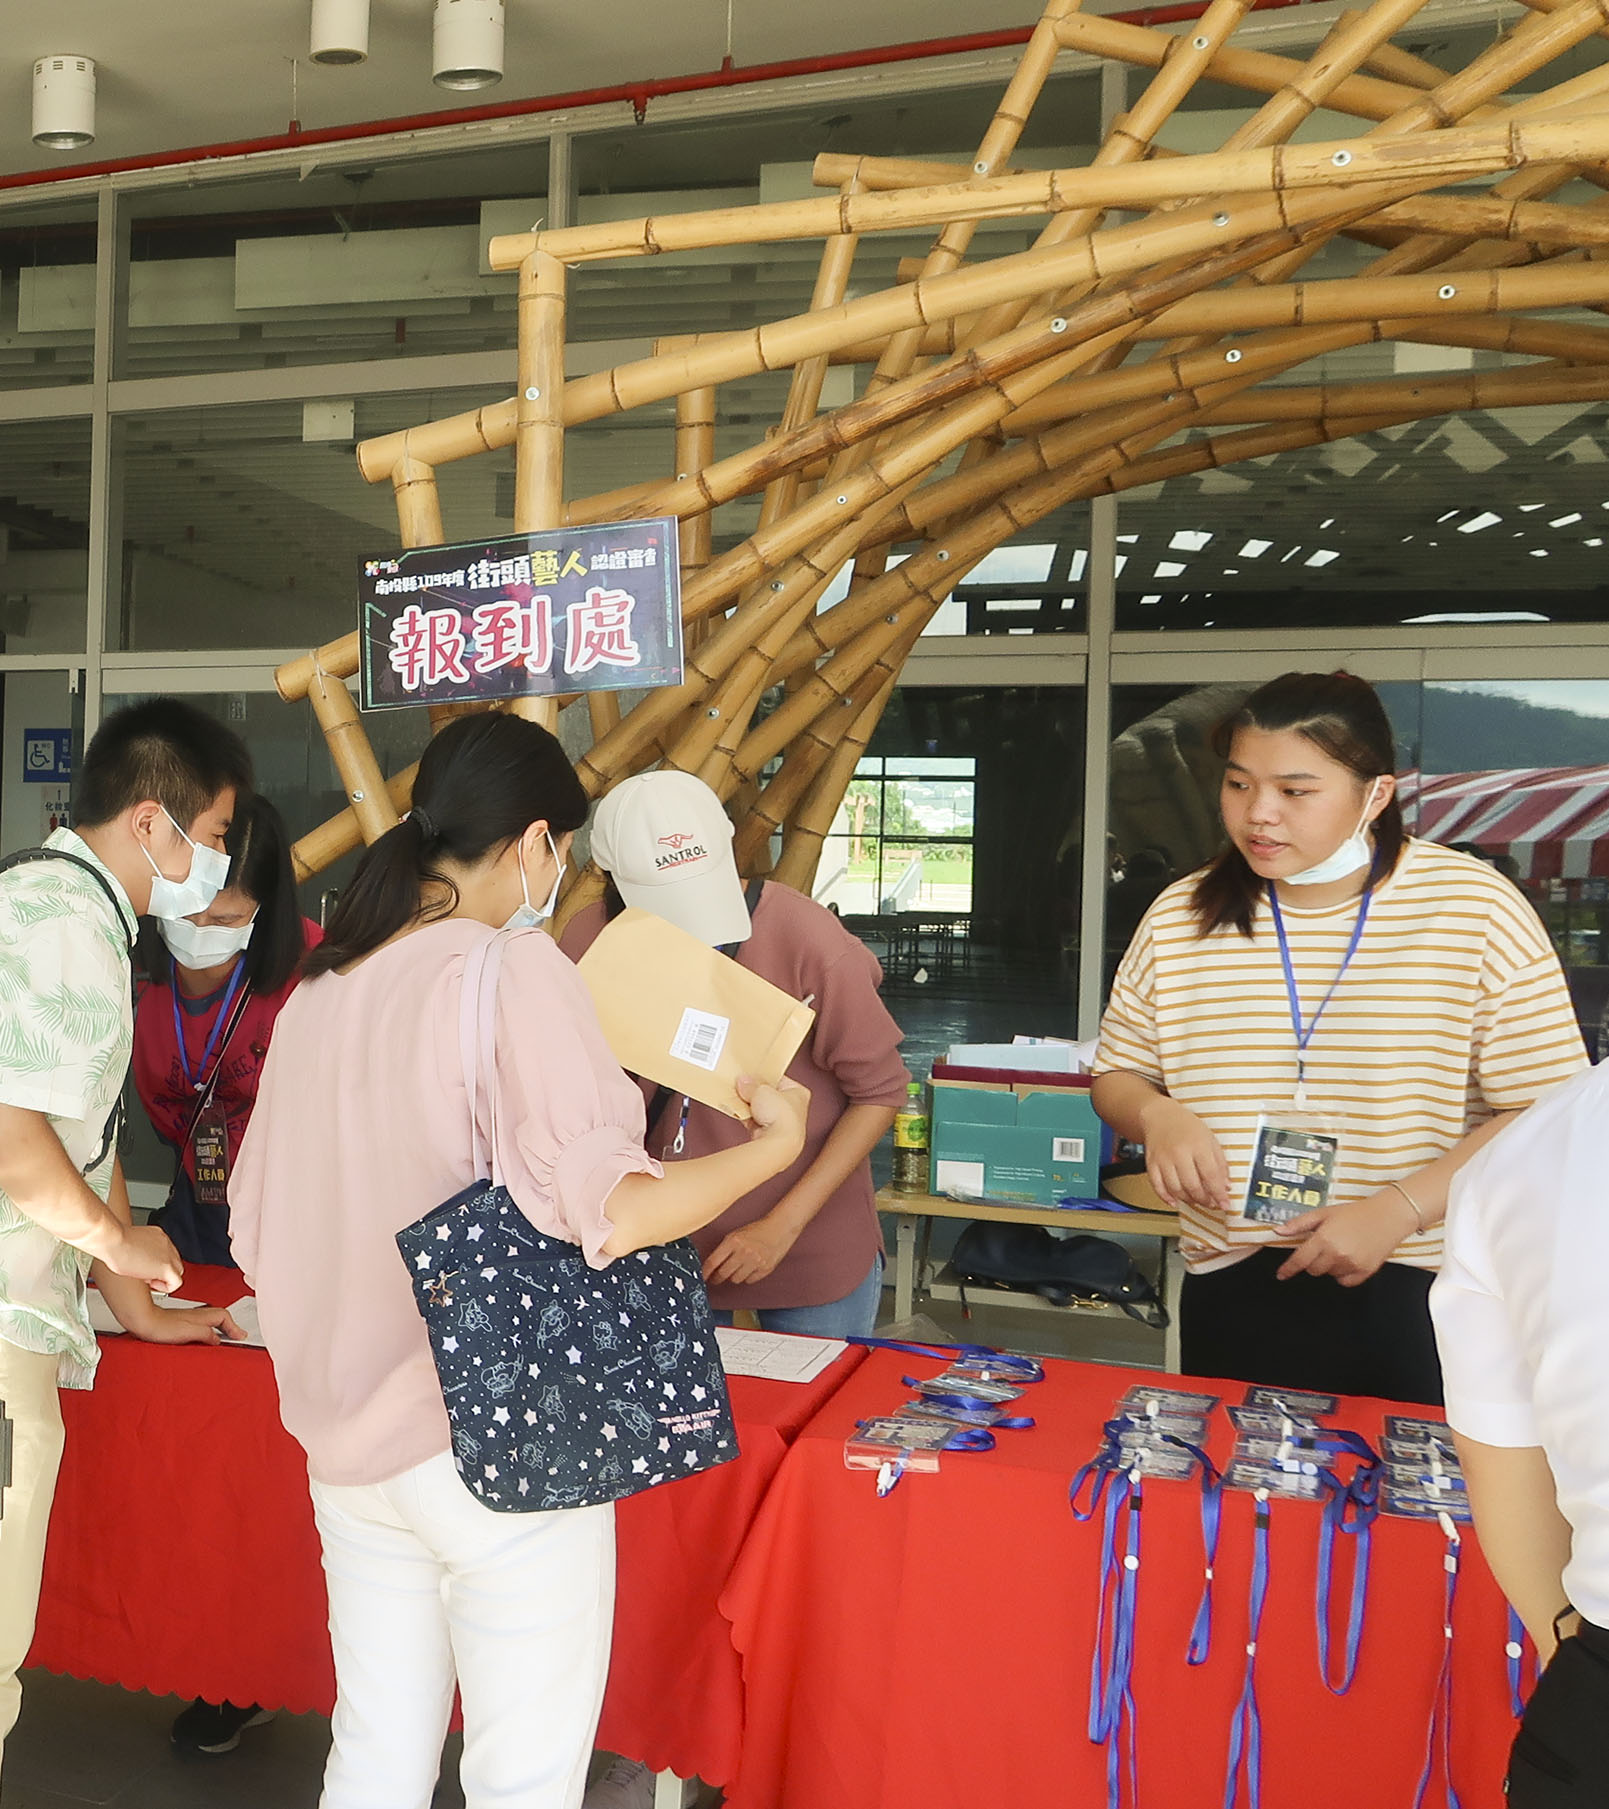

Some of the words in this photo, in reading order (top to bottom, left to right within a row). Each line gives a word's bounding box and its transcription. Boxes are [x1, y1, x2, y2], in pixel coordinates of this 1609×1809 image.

[375, 569, 466, 596] 南投縣109年度
[467, 550, 588, 589] 街頭藝人
[390, 588, 639, 688] 報到處
[655, 845, 708, 867] SANTROL
[1255, 1181, 1321, 1208] 工作人員
